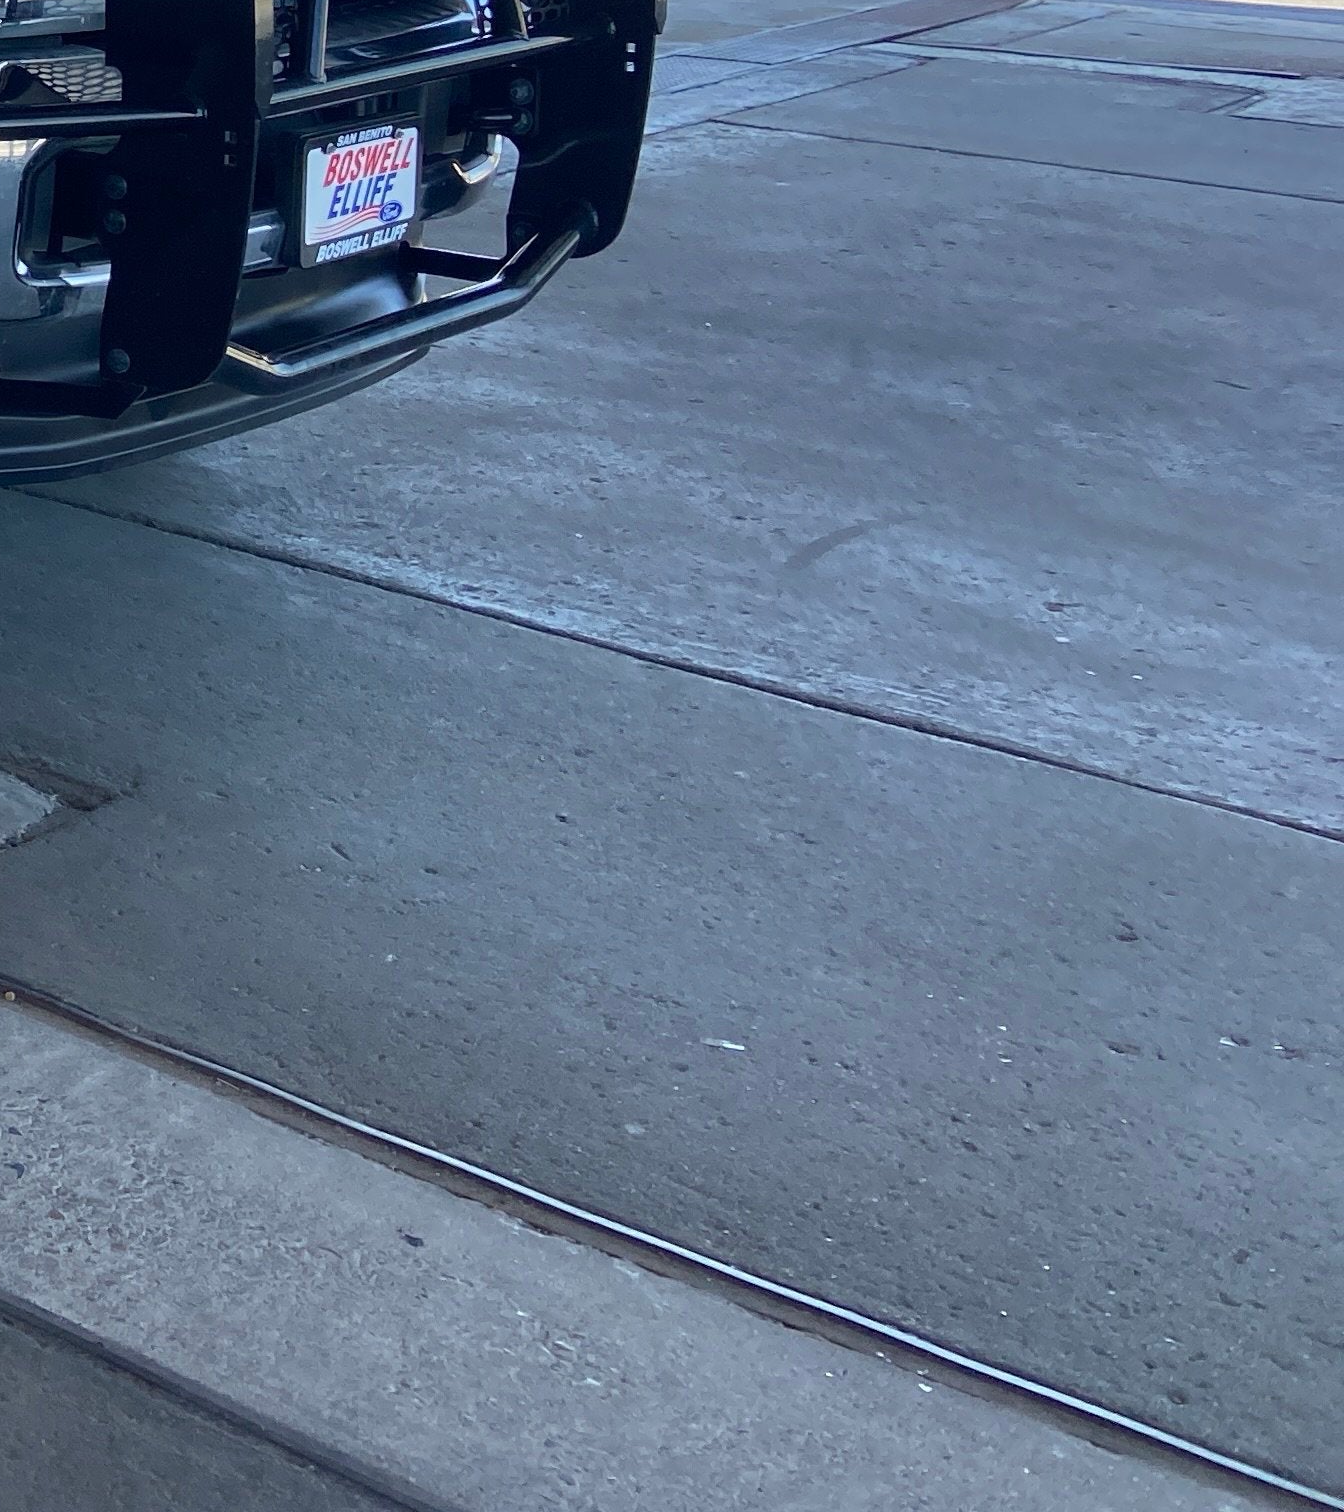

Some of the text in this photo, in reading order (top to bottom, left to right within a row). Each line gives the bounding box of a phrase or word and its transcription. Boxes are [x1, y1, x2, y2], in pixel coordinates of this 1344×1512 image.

[336, 125, 393, 148] SAN BENITO
[323, 137, 415, 188] BOSWELL
[327, 172, 397, 220] ELLIFF
[315, 222, 409, 264] BOSWELL ELLIFF
